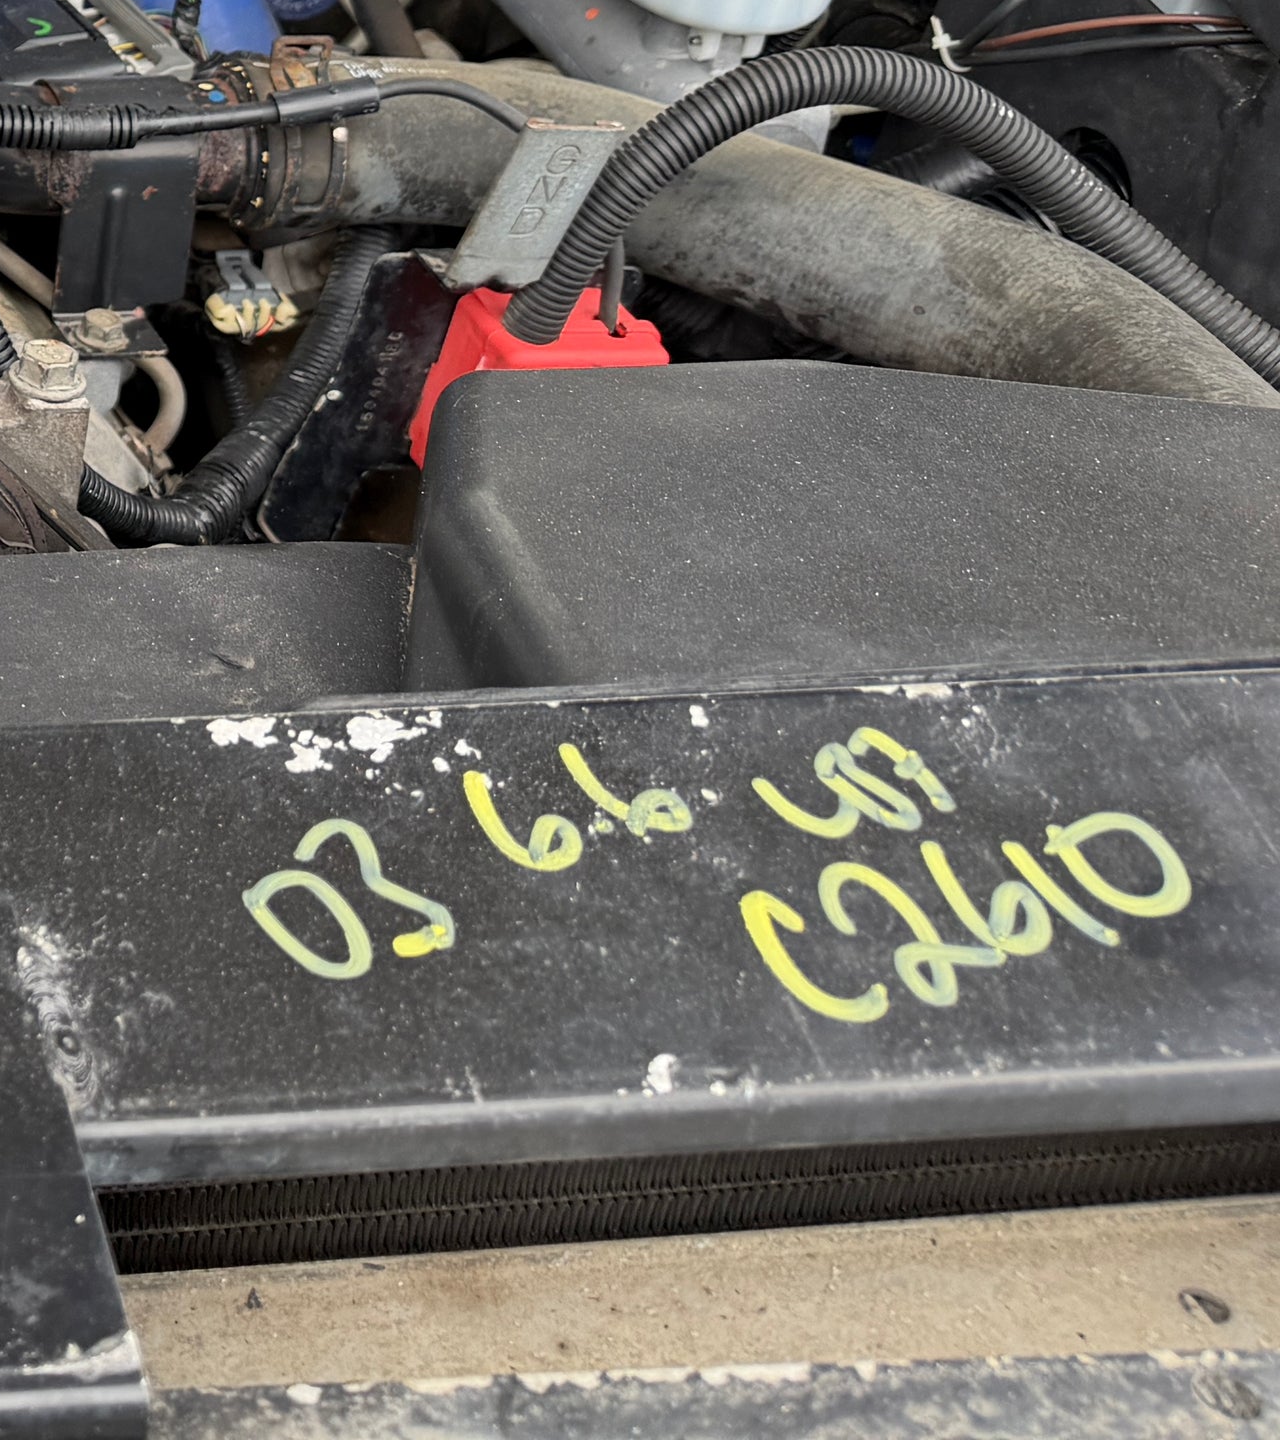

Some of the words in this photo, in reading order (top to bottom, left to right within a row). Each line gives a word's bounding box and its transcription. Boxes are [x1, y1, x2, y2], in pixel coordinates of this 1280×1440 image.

[508, 144, 582, 239] GND
[241, 818, 455, 980] 03
[463, 743, 693, 872] 6.6
[740, 811, 1193, 1024] C2610
